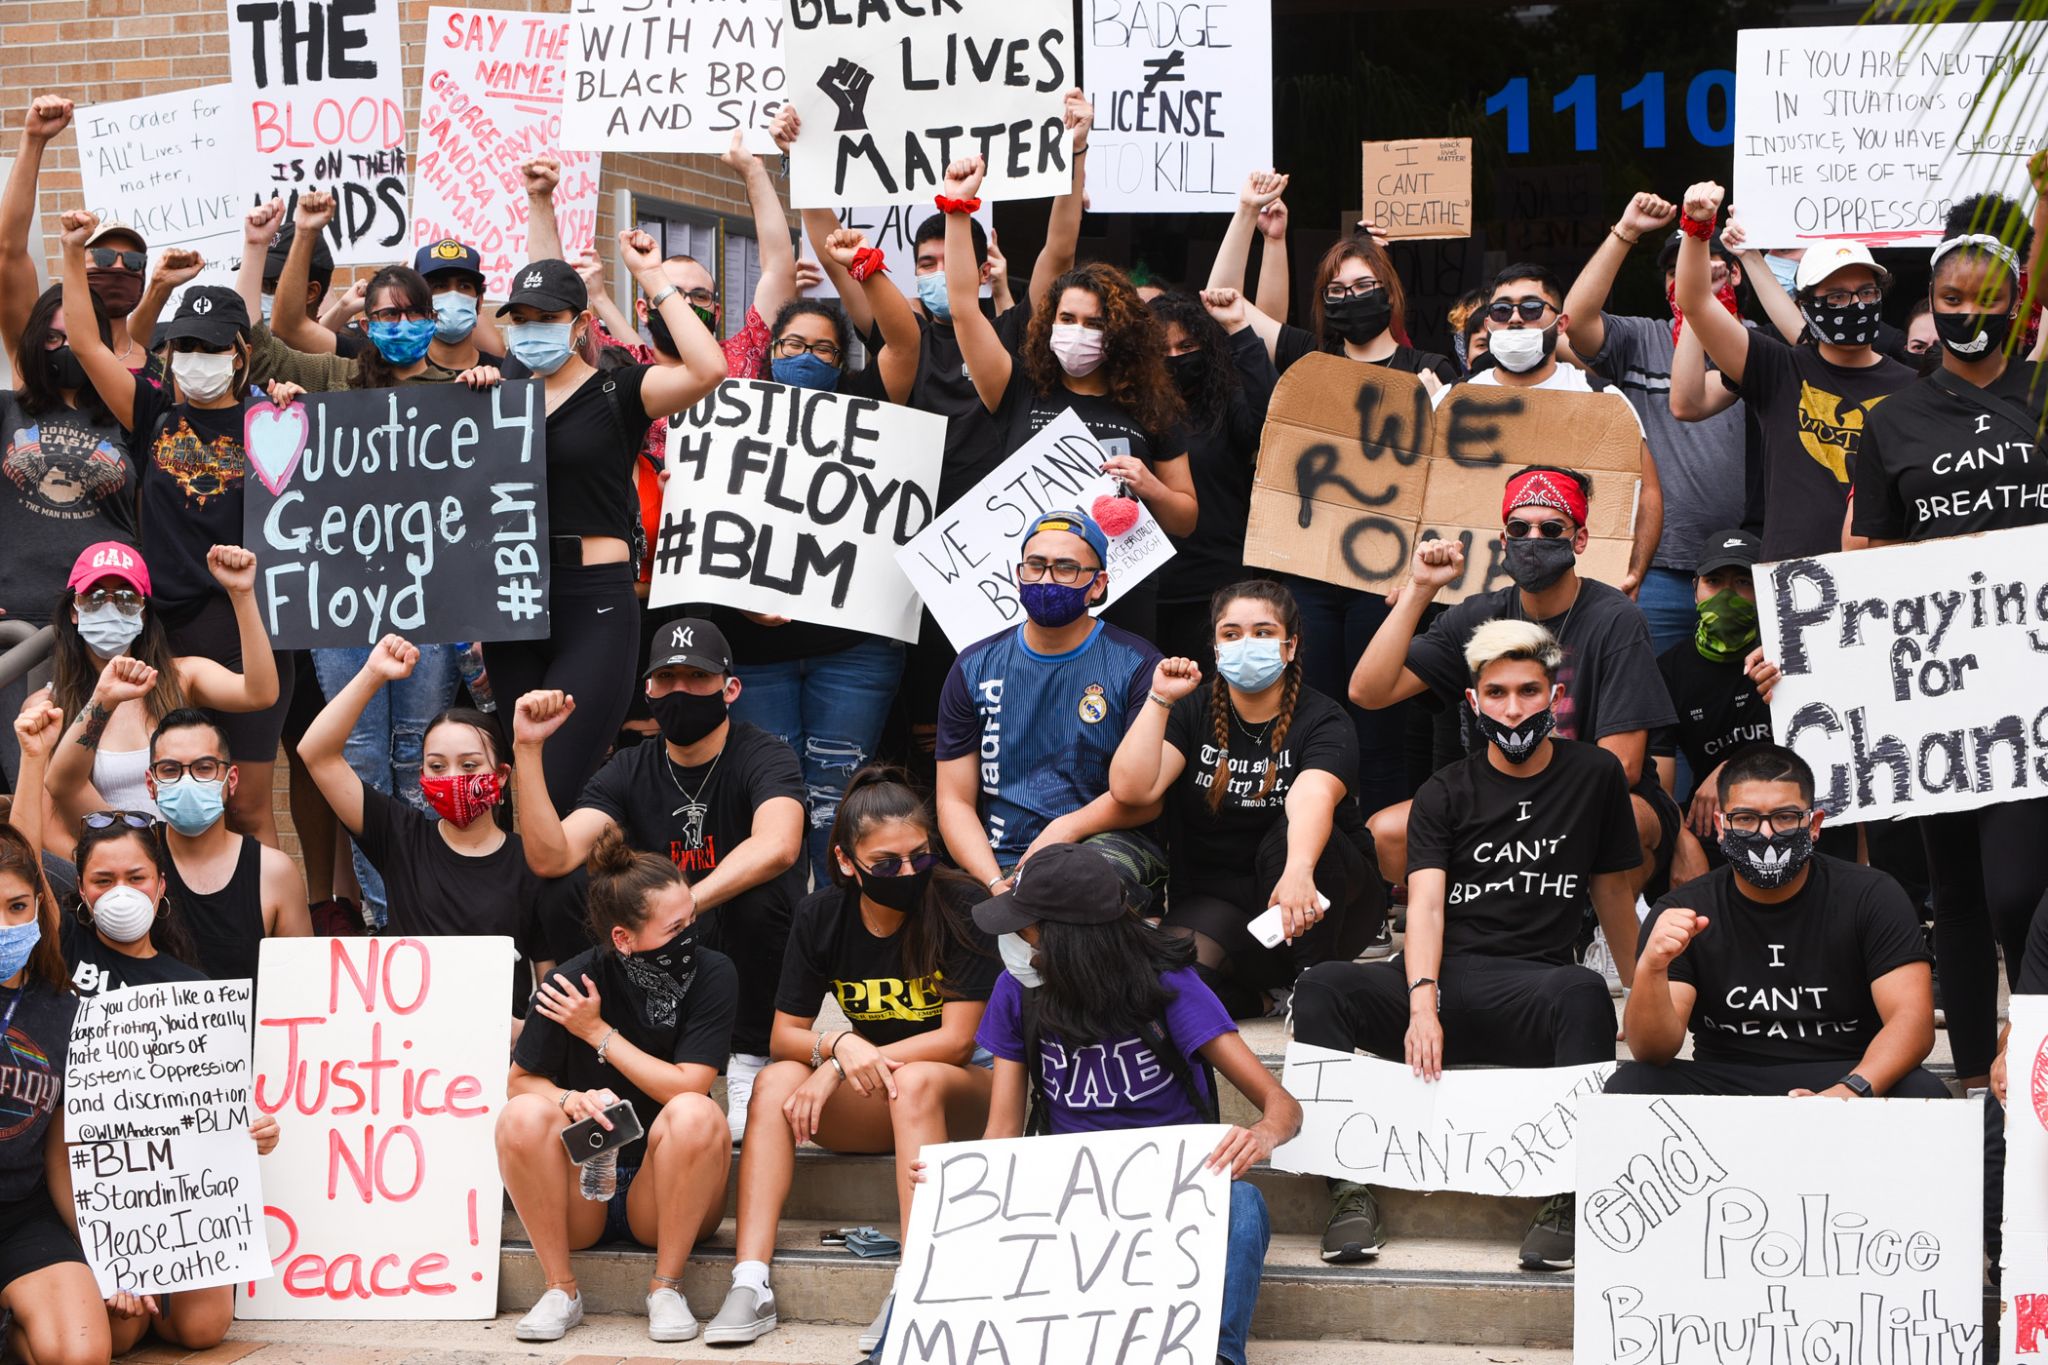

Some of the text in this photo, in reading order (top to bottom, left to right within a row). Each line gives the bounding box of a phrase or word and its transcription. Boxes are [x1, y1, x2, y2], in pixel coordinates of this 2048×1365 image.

[237, 0, 377, 89] THE
[443, 13, 507, 52] SAY
[580, 16, 783, 62] WITH MY
[1093, 0, 1232, 48] BADGE
[901, 28, 1064, 92] LIVES
[1765, 49, 1791, 77] IF
[1803, 50, 1850, 79] YOU
[1860, 50, 1909, 78] ARE
[89, 117, 120, 139] In
[192, 99, 221, 120] for
[252, 97, 405, 154] BLOOD
[429, 69, 501, 151] GEORGE
[607, 99, 789, 137] AND SIS
[1090, 89, 1225, 138] LICENSE
[1775, 90, 1798, 123] IN
[1823, 89, 1946, 117] SITUATIONS
[191, 133, 215, 150] to
[421, 104, 495, 209] SANDRA
[834, 116, 1066, 195] MATTER
[1853, 127, 1887, 150] YOU
[1895, 131, 1946, 150] HAVE
[271, 145, 406, 182] IS ON THEIR
[1093, 141, 1236, 195] TO KILL
[1377, 173, 1435, 196] CANT
[1766, 163, 1942, 186] THE SIDE OF THE
[182, 194, 240, 228] LIVE
[418, 150, 503, 253] AHMAUD
[40, 426, 100, 444] JOHNNY
[40, 434, 98, 450] CASH
[302, 392, 479, 482] Justice
[491, 383, 534, 463] 4
[1355, 381, 1527, 469] WE
[1975, 415, 1991, 434] I
[1932, 442, 2035, 475] CAN'T
[679, 431, 933, 546] 4 FLOYD
[1294, 443, 1398, 529] R
[25, 501, 39, 513] THE
[41, 507, 61, 519] MAN
[62, 511, 71, 519] IN
[918, 435, 1107, 584] WE STAND
[263, 490, 467, 577] George
[490, 483, 543, 621] #BLM
[92, 548, 134, 570] GAP
[655, 508, 858, 609] #BLM
[265, 556, 425, 644] Floyd
[1890, 636, 1978, 702] for
[1195, 771, 1214, 789] no
[1227, 778, 1253, 798] try
[1251, 749, 1292, 776] shll
[1516, 801, 1532, 821] I
[1474, 835, 1566, 863] CAN'T
[72, 960, 128, 993] BL
[329, 938, 431, 1016] NO
[1768, 944, 1785, 967] I
[78, 996, 95, 1024] If
[101, 1001, 123, 1021] you
[127, 987, 168, 1012] don't
[172, 986, 198, 1007] like
[204, 991, 215, 1002] a
[1725, 986, 1828, 1012] CAN'T
[69, 1025, 96, 1047] days
[96, 1020, 113, 1037] of
[113, 1018, 162, 1042] rioting,
[202, 1010, 248, 1034] really
[69, 1034, 207, 1066] hate 400 years of
[255, 1016, 490, 1120] Justice
[1292, 1058, 1354, 1103] I
[68, 1093, 104, 1115] and
[180, 1105, 249, 1134] #BLM
[72, 1139, 174, 1178] #BLM
[328, 1124, 426, 1204] NO
[1335, 1112, 1487, 1185] CAN'T
[933, 1139, 1216, 1238] BLACK
[1584, 1098, 1728, 1254] end
[170, 1209, 198, 1249] I
[199, 1203, 253, 1243] can't
[1704, 1187, 1941, 1280] Police
[913, 1224, 1200, 1305] LIVES
[898, 1300, 1202, 1365] MATTER
[1602, 1285, 1983, 1365] Brutality
